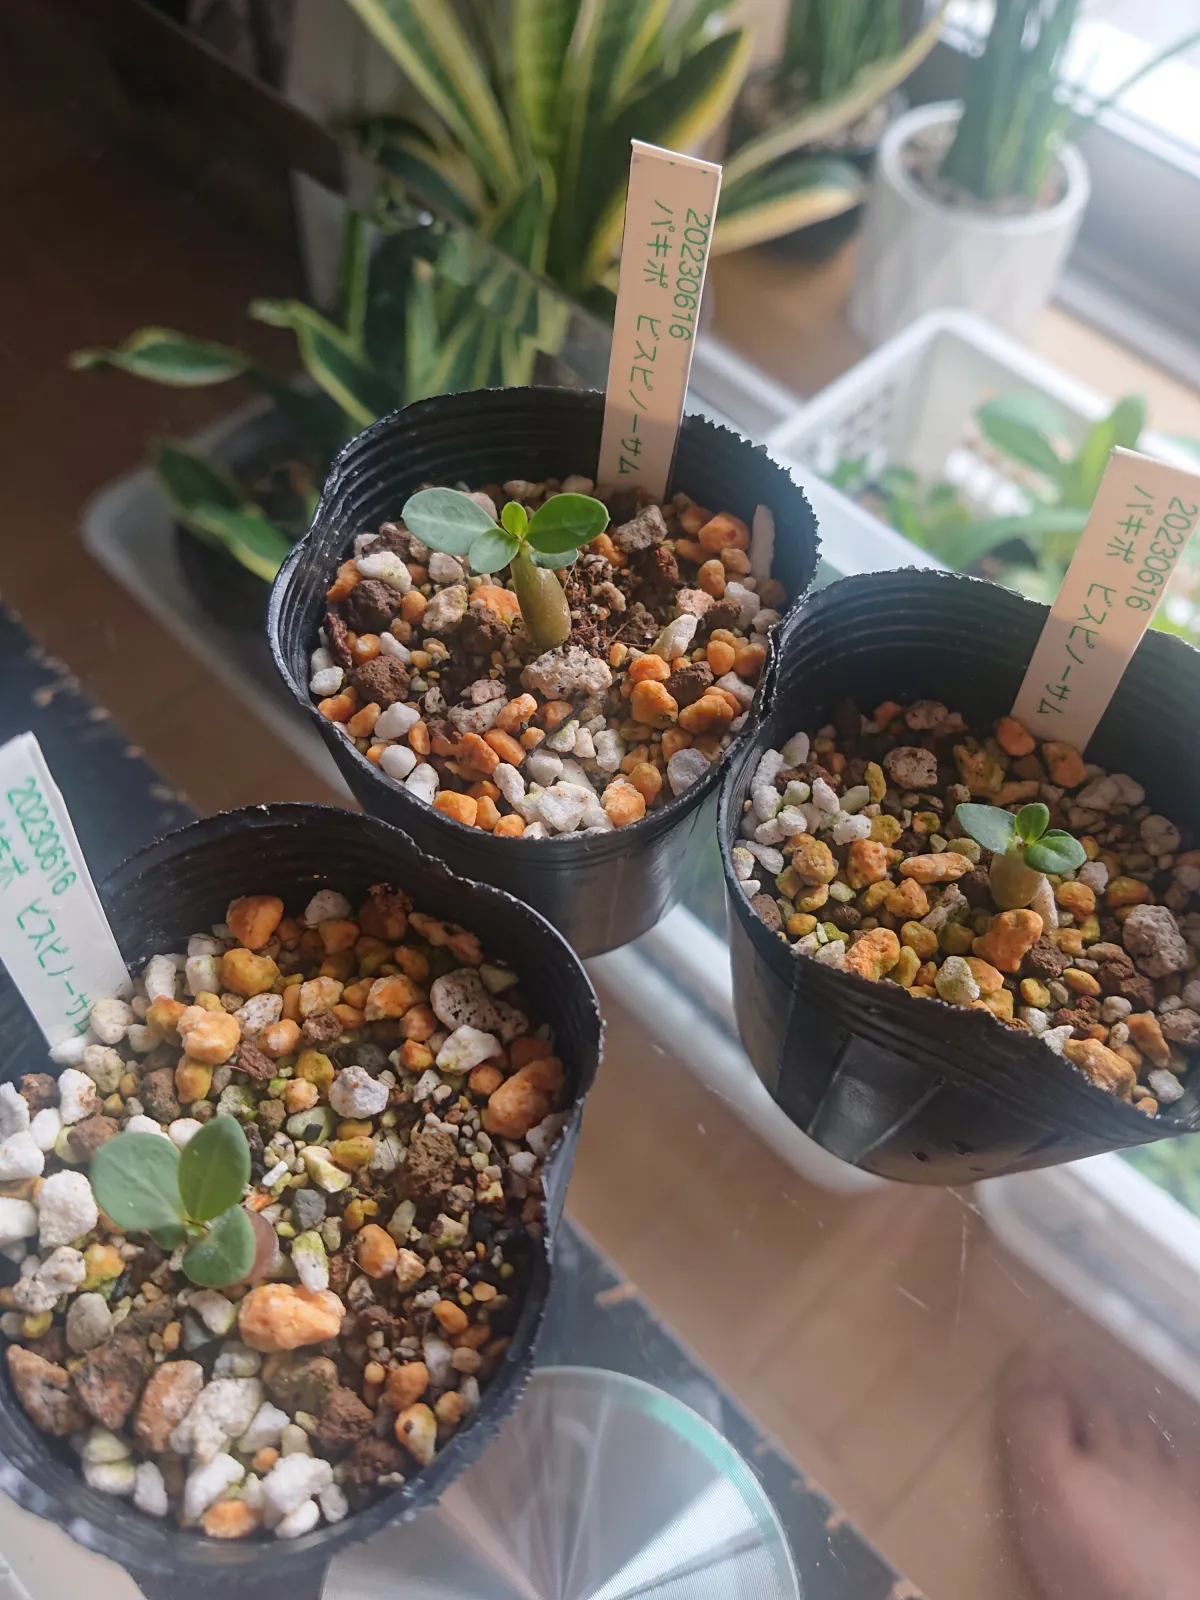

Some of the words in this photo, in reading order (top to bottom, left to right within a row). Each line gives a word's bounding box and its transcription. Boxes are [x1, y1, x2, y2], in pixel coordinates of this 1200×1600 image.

[642, 199, 674, 290] パキポ
[668, 207, 711, 342] 20230616
[617, 314, 662, 476] ビスピノーサム
[1105, 484, 1156, 565] パキポ
[1125, 496, 1198, 613] 20230616
[1036, 582, 1118, 715] ビスピノーサム
[6, 777, 77, 895] 20230616
